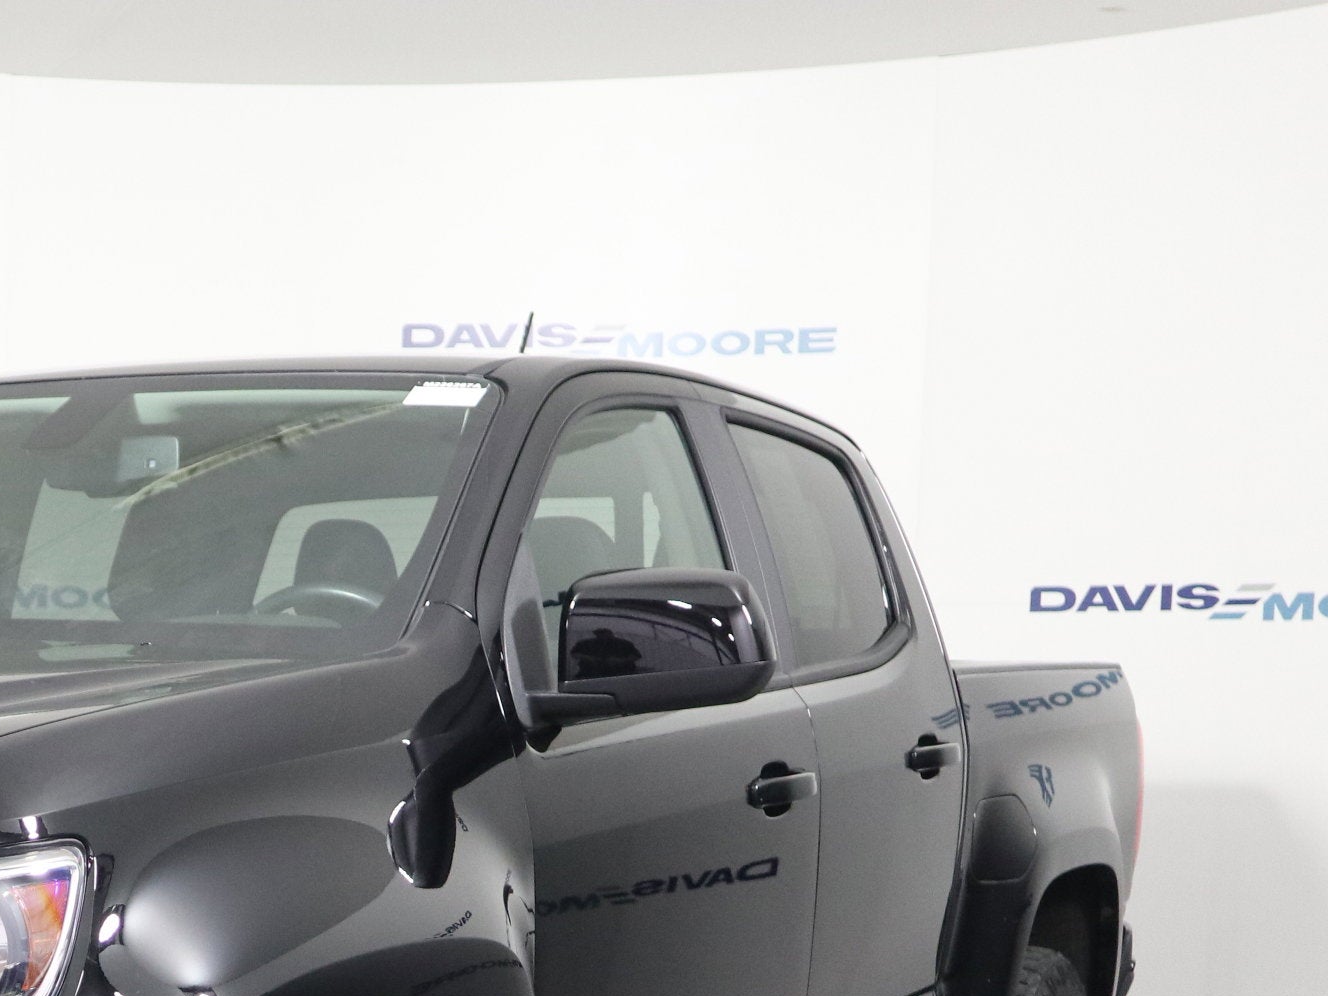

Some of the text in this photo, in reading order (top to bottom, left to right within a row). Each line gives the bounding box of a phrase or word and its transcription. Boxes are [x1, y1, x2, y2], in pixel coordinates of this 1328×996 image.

[401, 322, 838, 358] DAVIS MOORE
[1029, 583, 1328, 621] DAVIS M
